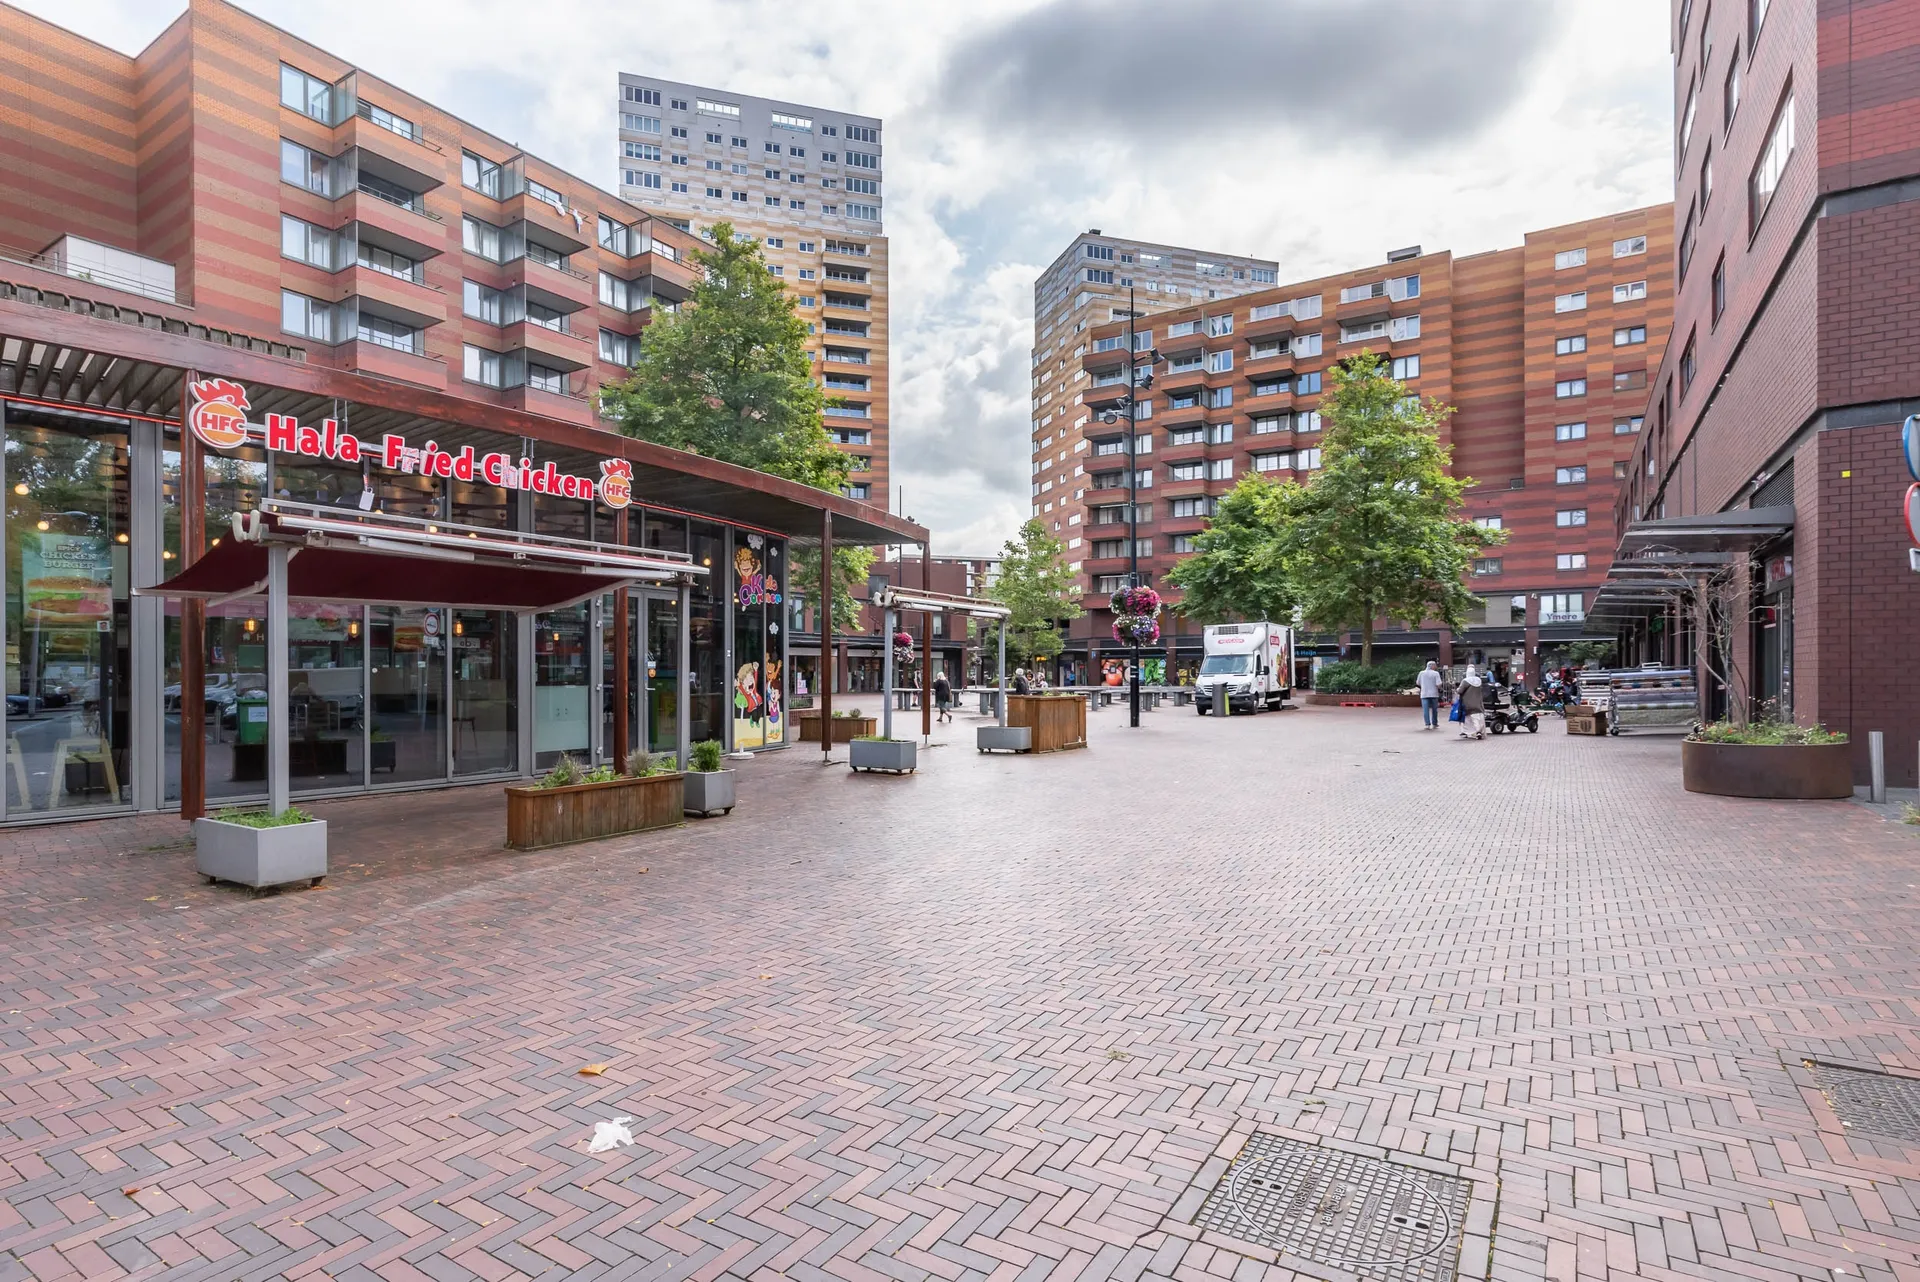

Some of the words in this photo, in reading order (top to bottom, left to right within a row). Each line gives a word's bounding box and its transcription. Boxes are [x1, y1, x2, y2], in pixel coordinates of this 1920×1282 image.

[201, 412, 246, 435] HFC
[265, 412, 362, 464] Hala
[383, 433, 475, 482] Fried
[481, 453, 595, 501] Chicken
[606, 483, 630, 498] HFC
[57, 544, 81, 552] SPICY
[40, 551, 97, 561] CHICKEN
[44, 560, 95, 570] BURGER
